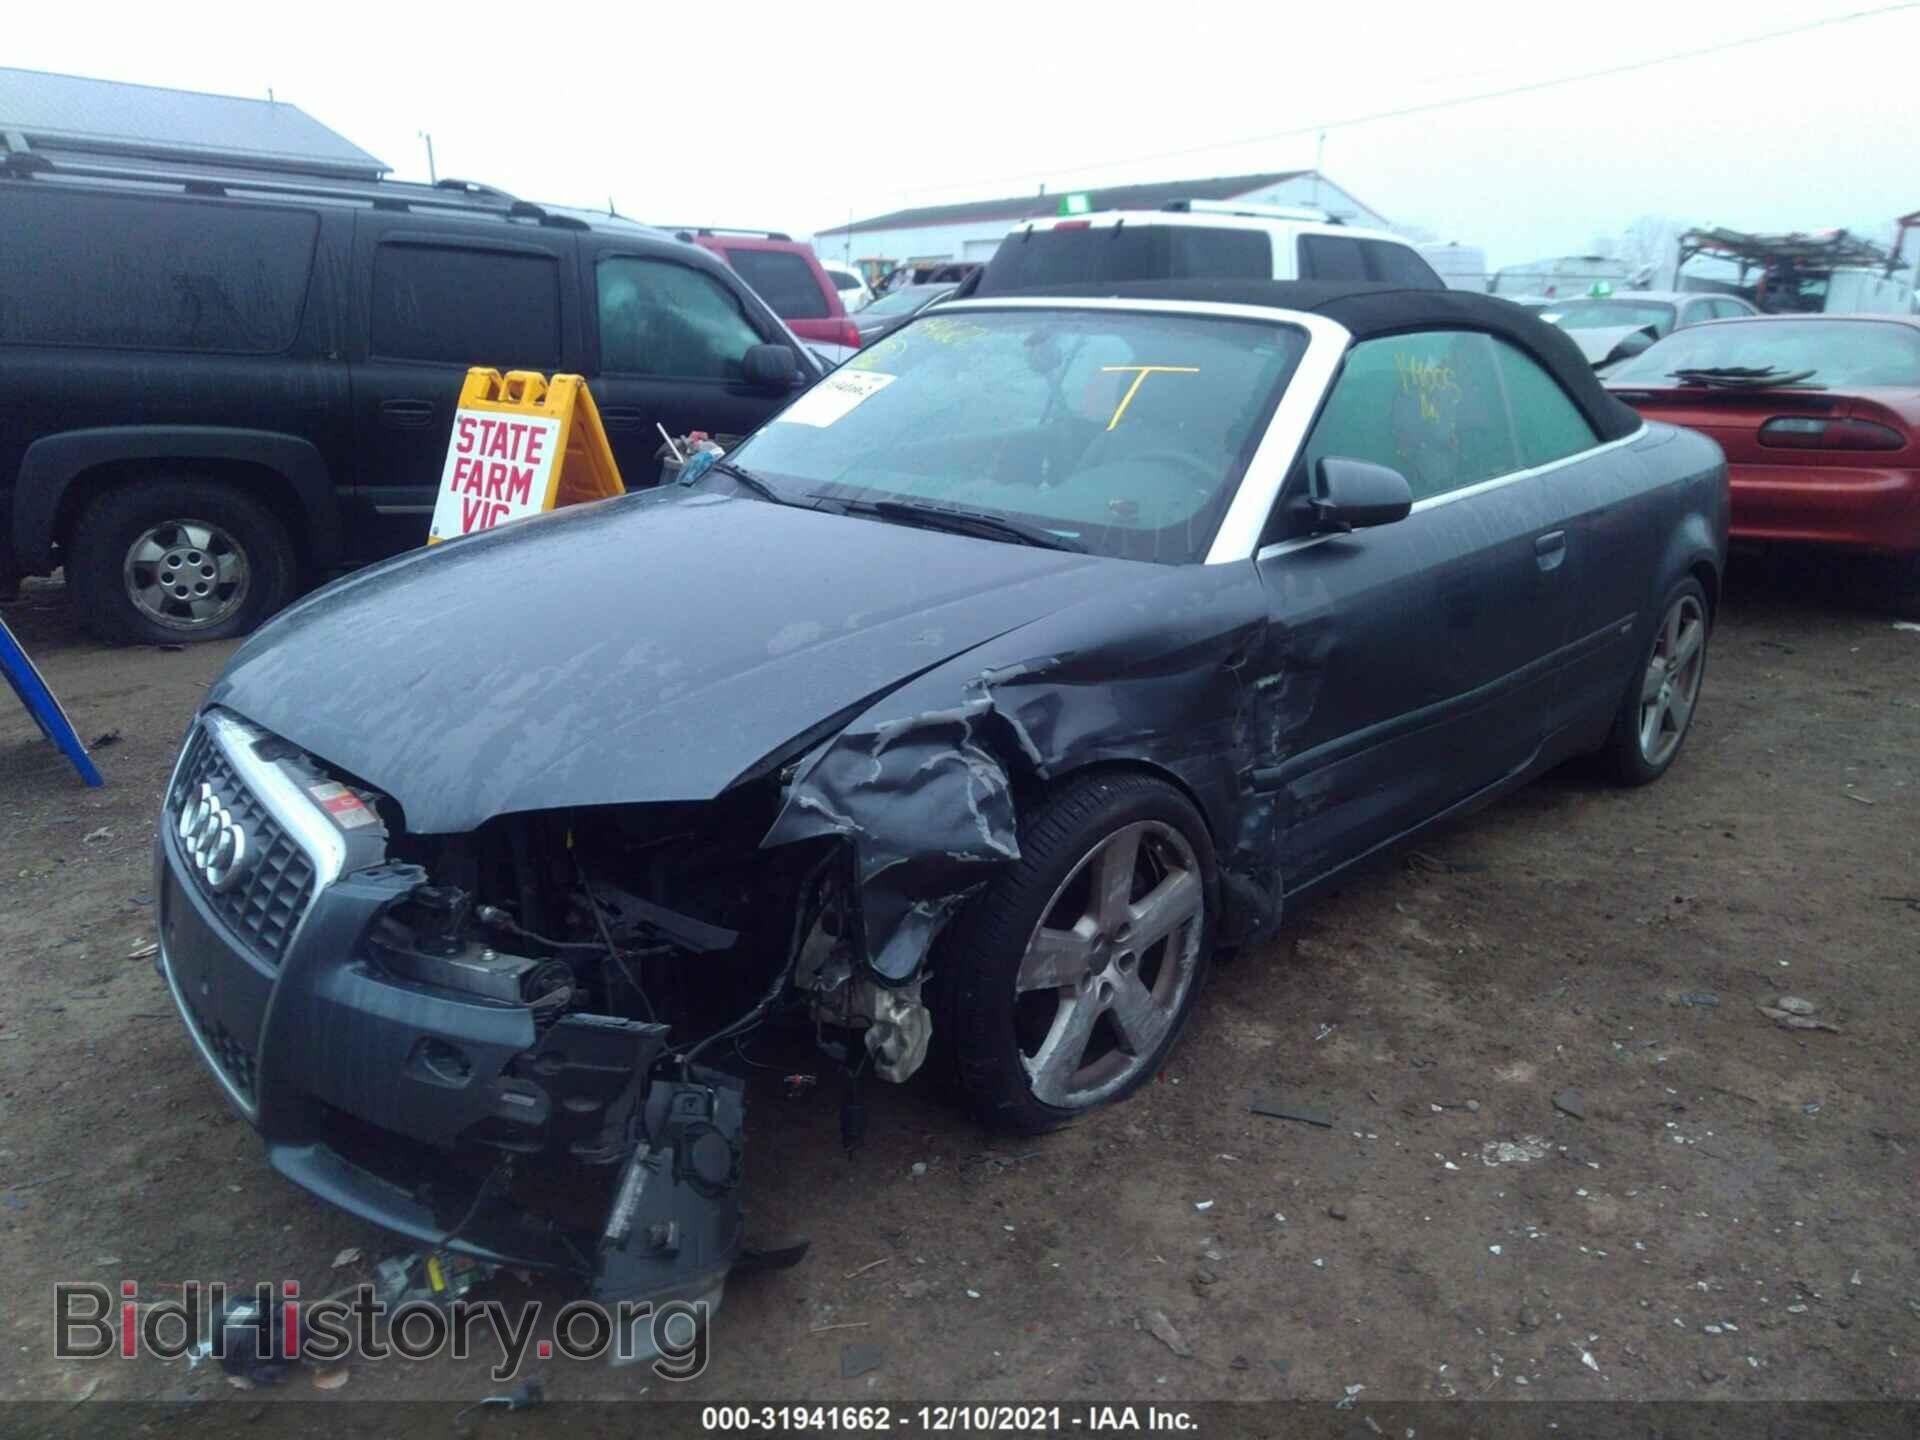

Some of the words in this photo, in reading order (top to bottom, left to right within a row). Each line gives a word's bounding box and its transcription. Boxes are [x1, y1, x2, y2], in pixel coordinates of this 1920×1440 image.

[1101, 366, 1200, 431] T
[456, 418, 547, 465] STATE
[450, 457, 534, 506] FARM
